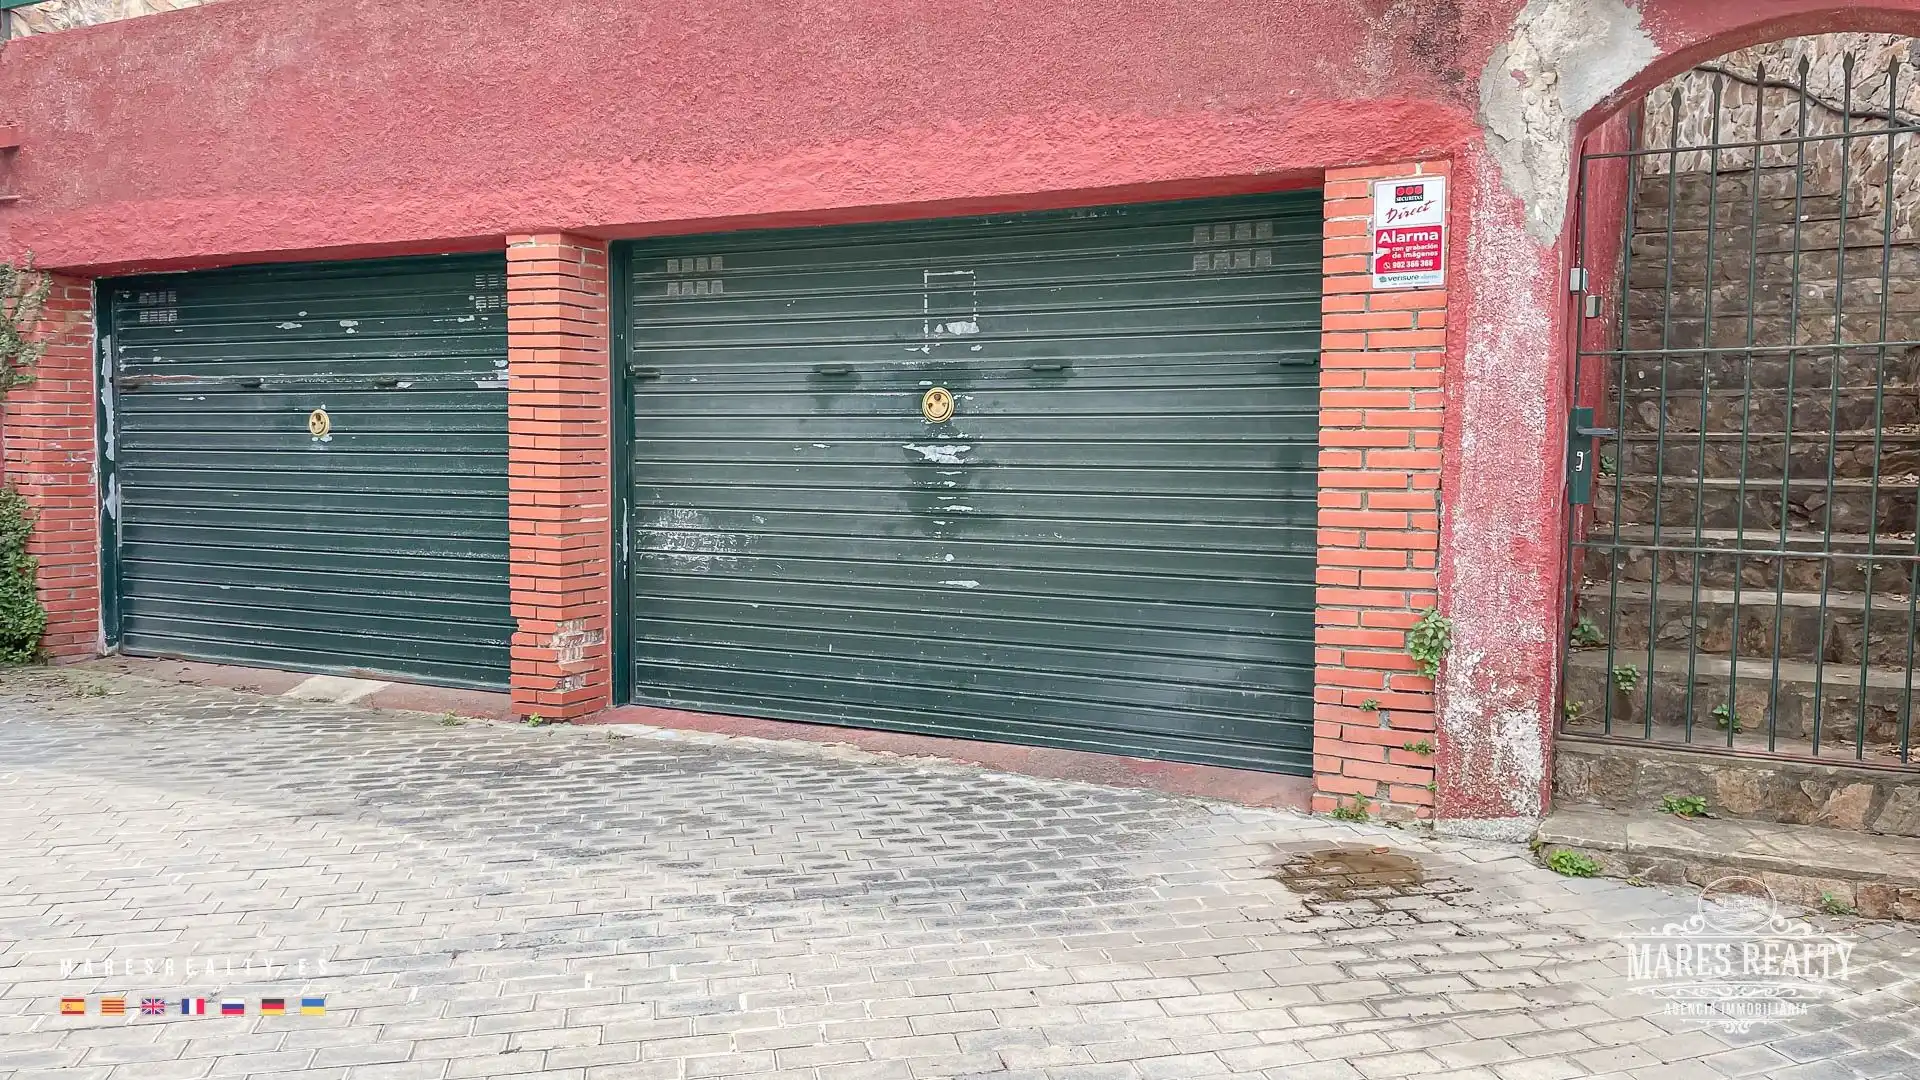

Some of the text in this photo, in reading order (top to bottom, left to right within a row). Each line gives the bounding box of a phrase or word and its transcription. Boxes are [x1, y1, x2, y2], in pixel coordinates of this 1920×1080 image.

[1386, 200, 1436, 223] Direct
[1378, 230, 1439, 244] Alarma
[1405, 243, 1439, 252] grabación
[1392, 250, 1439, 259] de imágenes
[1392, 261, 1405, 269] 902
